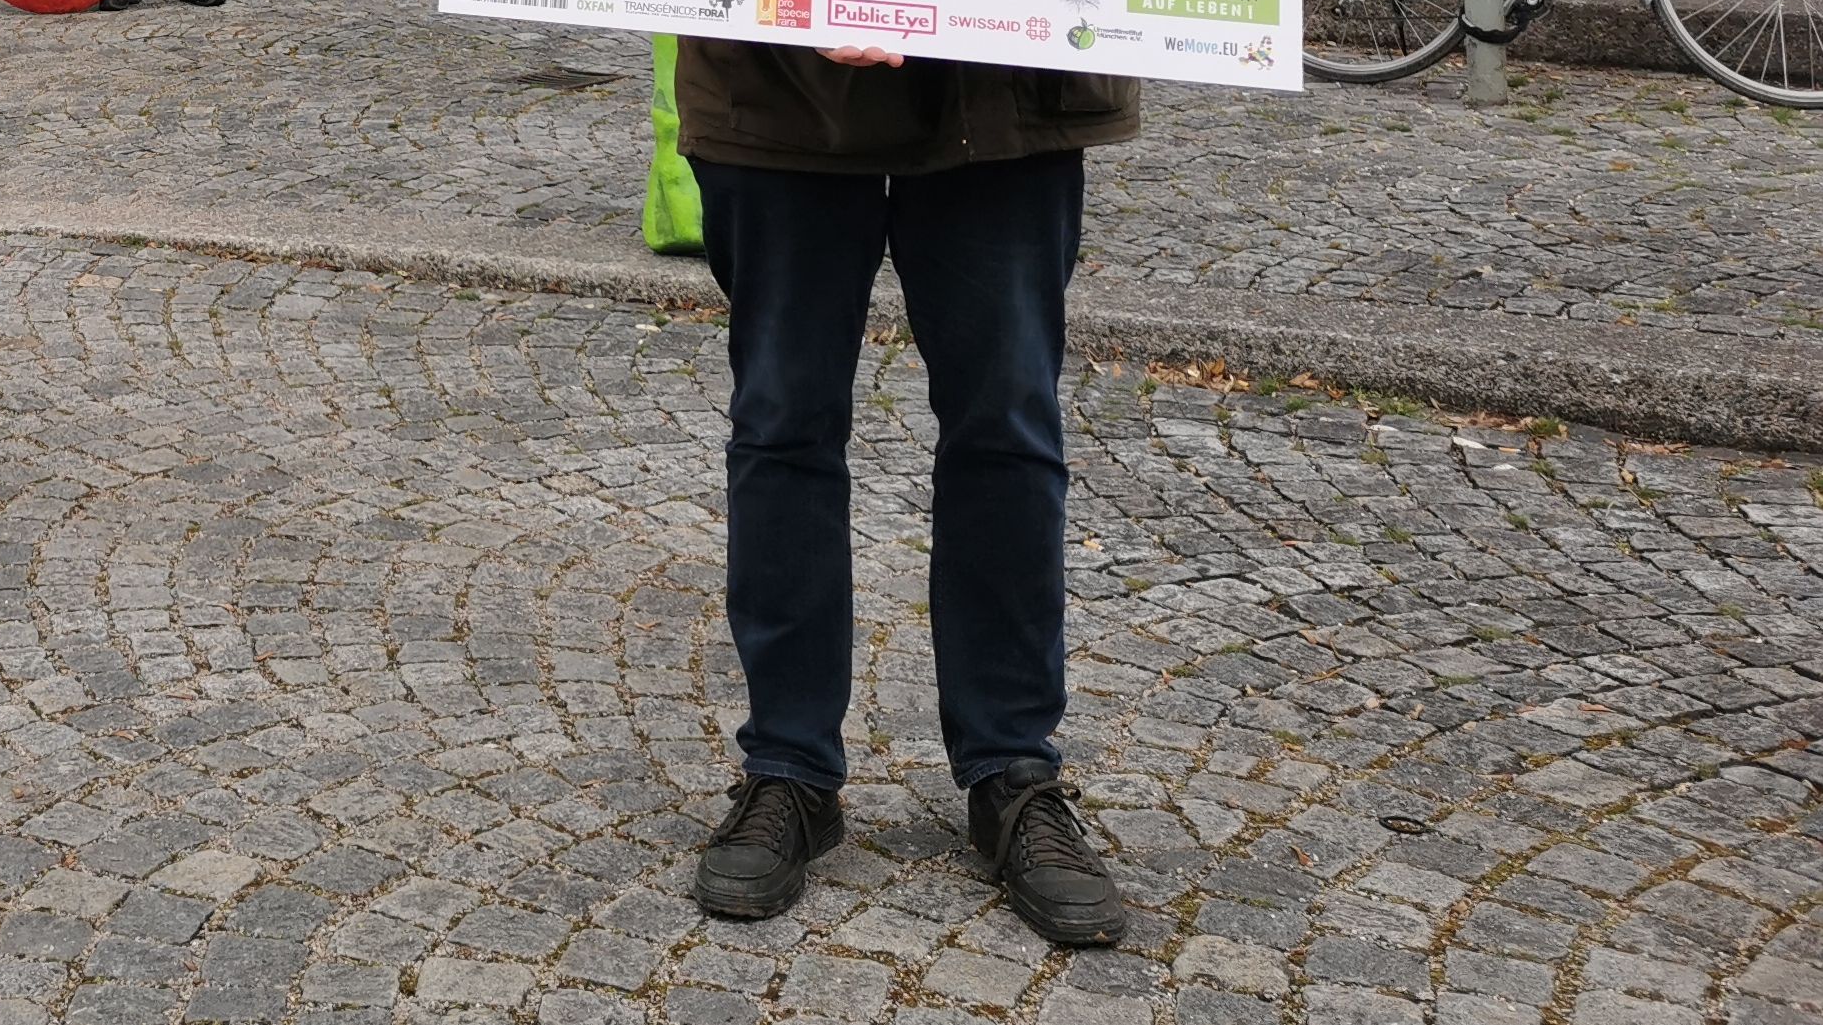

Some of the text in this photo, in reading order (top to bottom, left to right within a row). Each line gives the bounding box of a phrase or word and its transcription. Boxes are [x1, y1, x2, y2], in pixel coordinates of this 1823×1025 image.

[577, 0, 614, 13] OXFAM
[624, 0, 697, 17] TRANSGÉNICOS
[698, 7, 725, 19] FORA
[777, 0, 794, 10] pro
[777, 9, 810, 20] specie
[834, 3, 930, 31] Public Eye
[777, 18, 797, 27] rara
[948, 15, 1021, 32] SWISSAID
[1164, 36, 1238, 56] WeMove.EU
